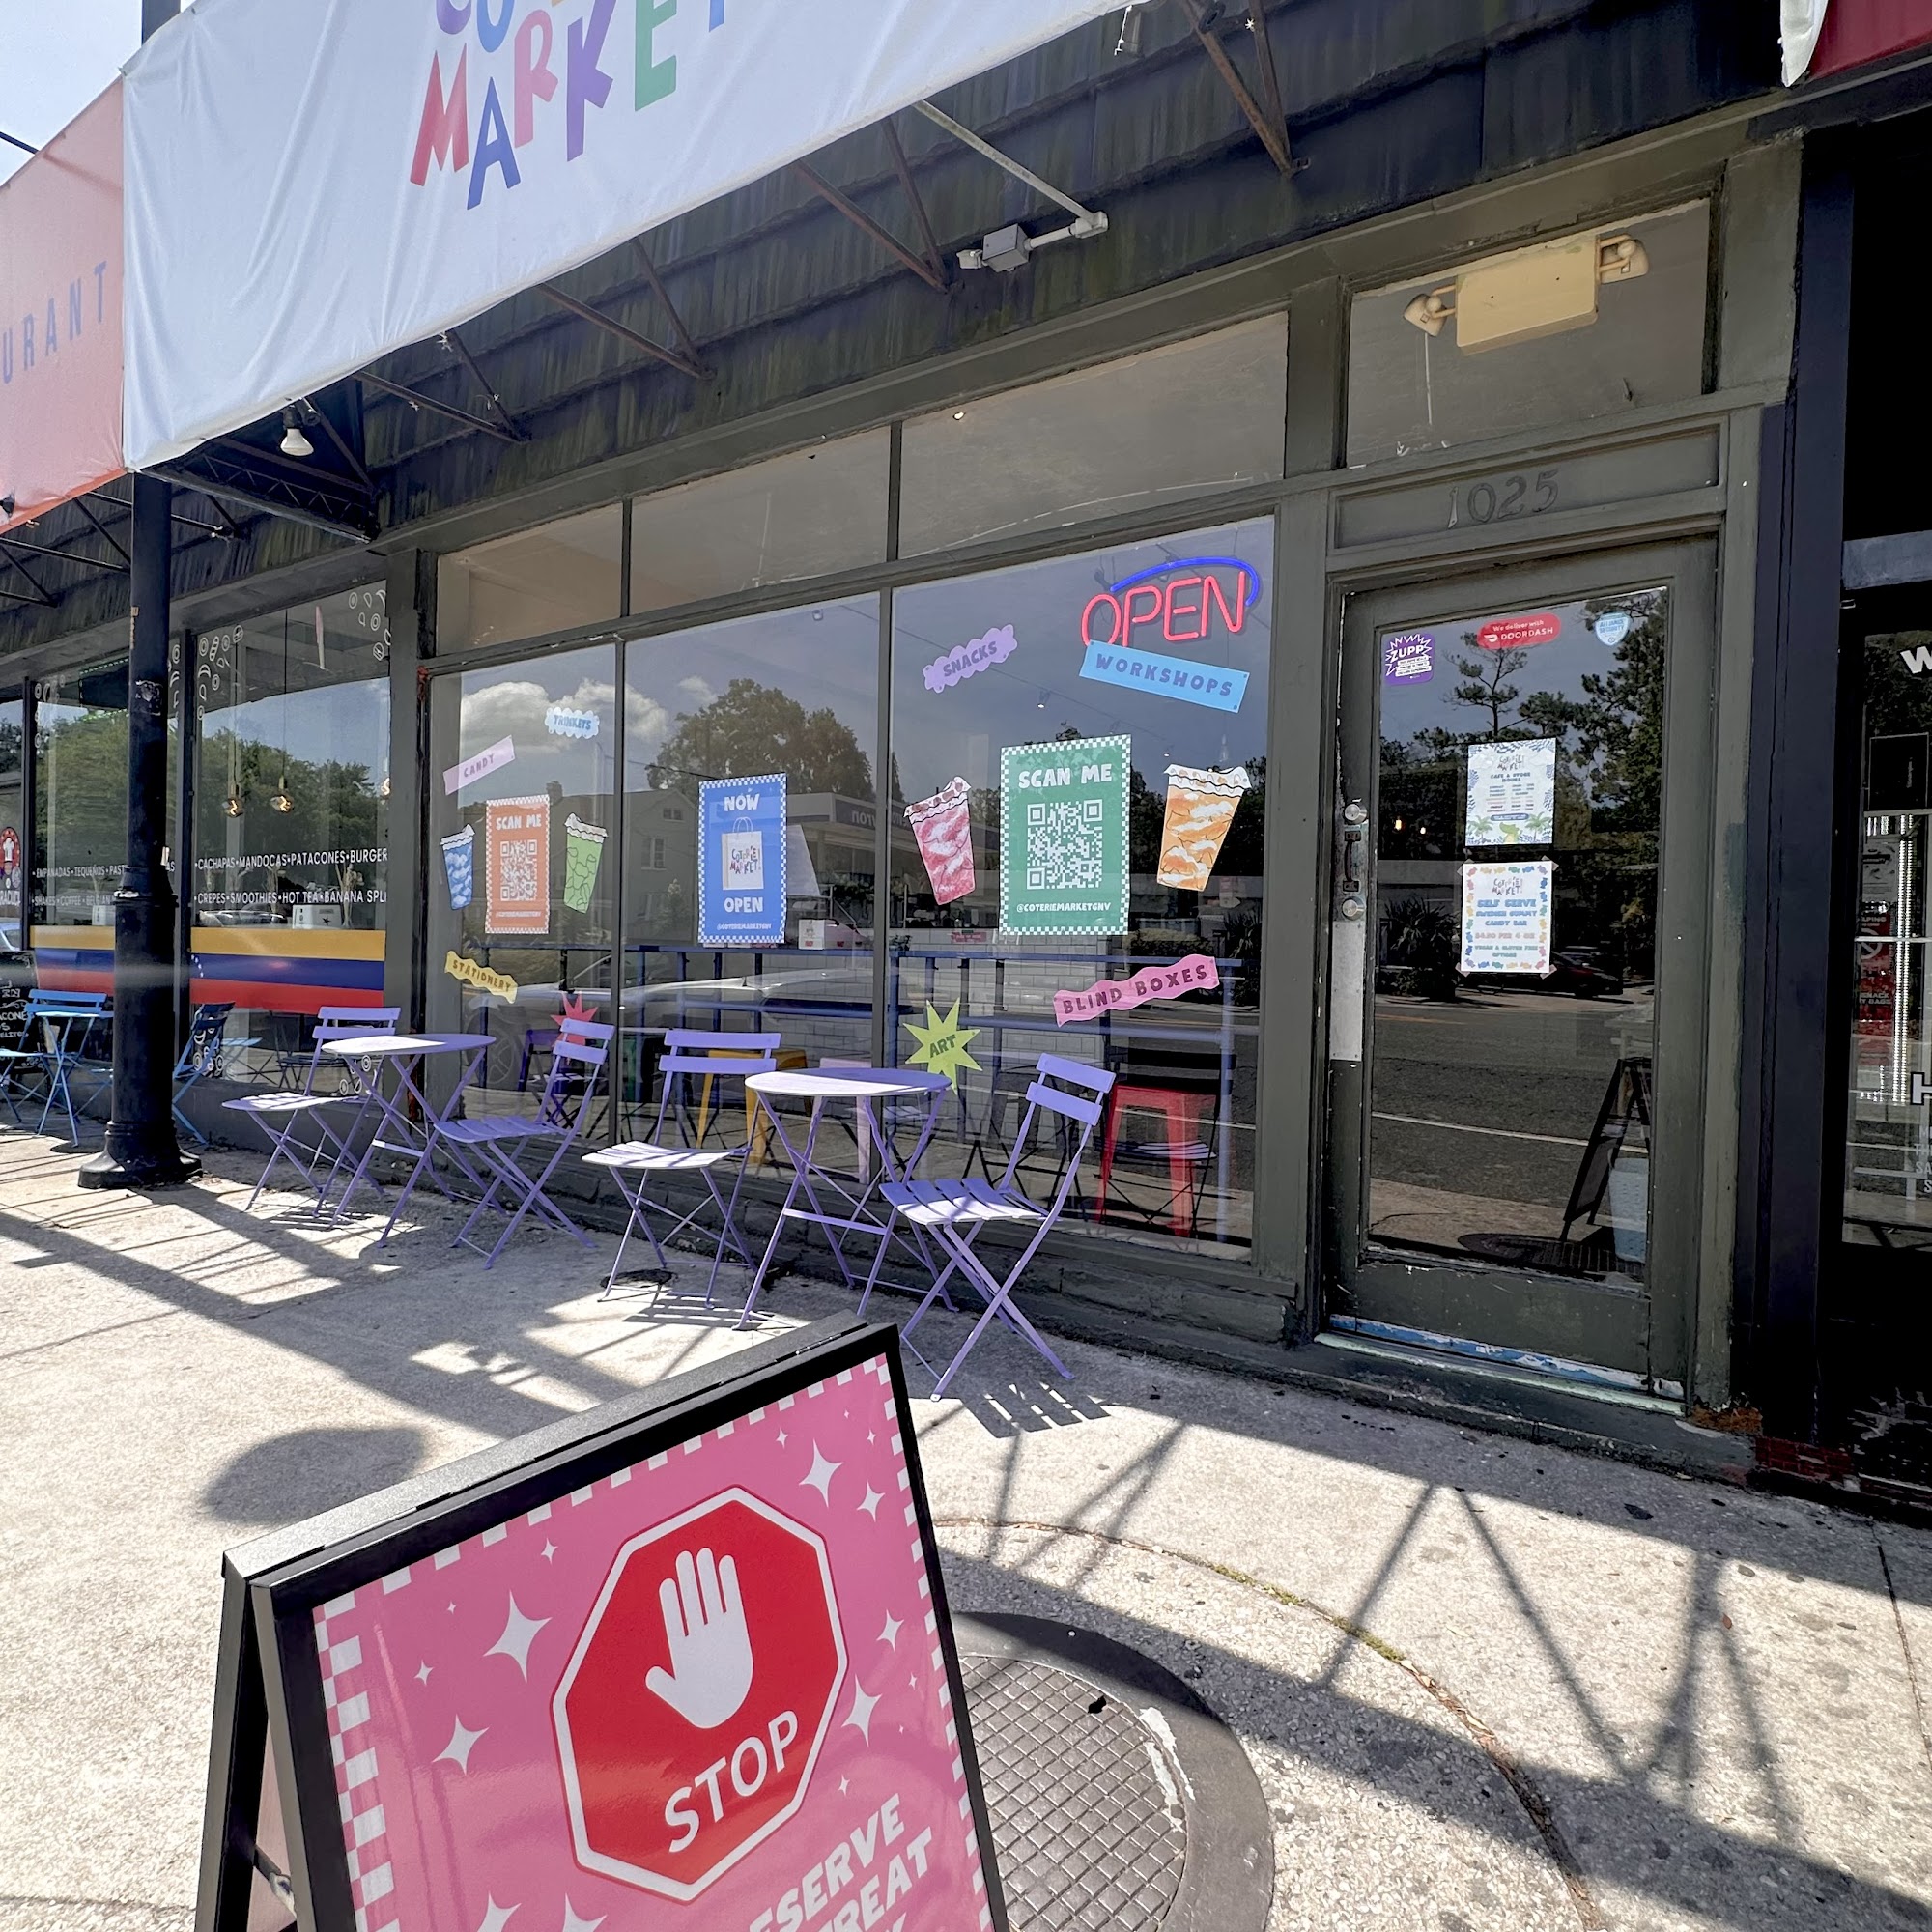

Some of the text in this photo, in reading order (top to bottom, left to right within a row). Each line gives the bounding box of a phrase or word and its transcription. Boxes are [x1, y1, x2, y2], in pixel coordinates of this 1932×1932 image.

[1448, 468, 1559, 529] 1025
[1082, 571, 1246, 647] OPEN
[1501, 627, 1553, 640] DOORDASH
[943, 641, 998, 678] SNACKS
[1095, 653, 1233, 696] WORKSHOPS
[554, 715, 591, 730] TRINKETS
[464, 753, 495, 778] CANDY
[1018, 764, 1112, 788] SCAN ME
[724, 793, 760, 811] NOW
[497, 814, 541, 830] SCAN ME
[198, 856, 236, 869] CACHAPAS
[240, 854, 287, 867] MANDOCAS
[290, 850, 346, 866] PATACONES
[37, 867, 71, 878] EMPANADAS
[197, 892, 226, 904] CREPES
[230, 892, 278, 904] SMOOTHIES
[282, 891, 300, 904] HOT
[302, 891, 318, 903] TEA
[324, 891, 364, 903] BANANA
[724, 896, 763, 912] OPEN
[1017, 902, 1111, 913] @COTERIEMARKETGNV
[452, 959, 512, 993] STATIONERY
[1064, 965, 1208, 1015] BLIND BOXES
[929, 1035, 956, 1058] ART
[664, 1710, 799, 1853] STOP
[819, 1826, 932, 1932] REAT
